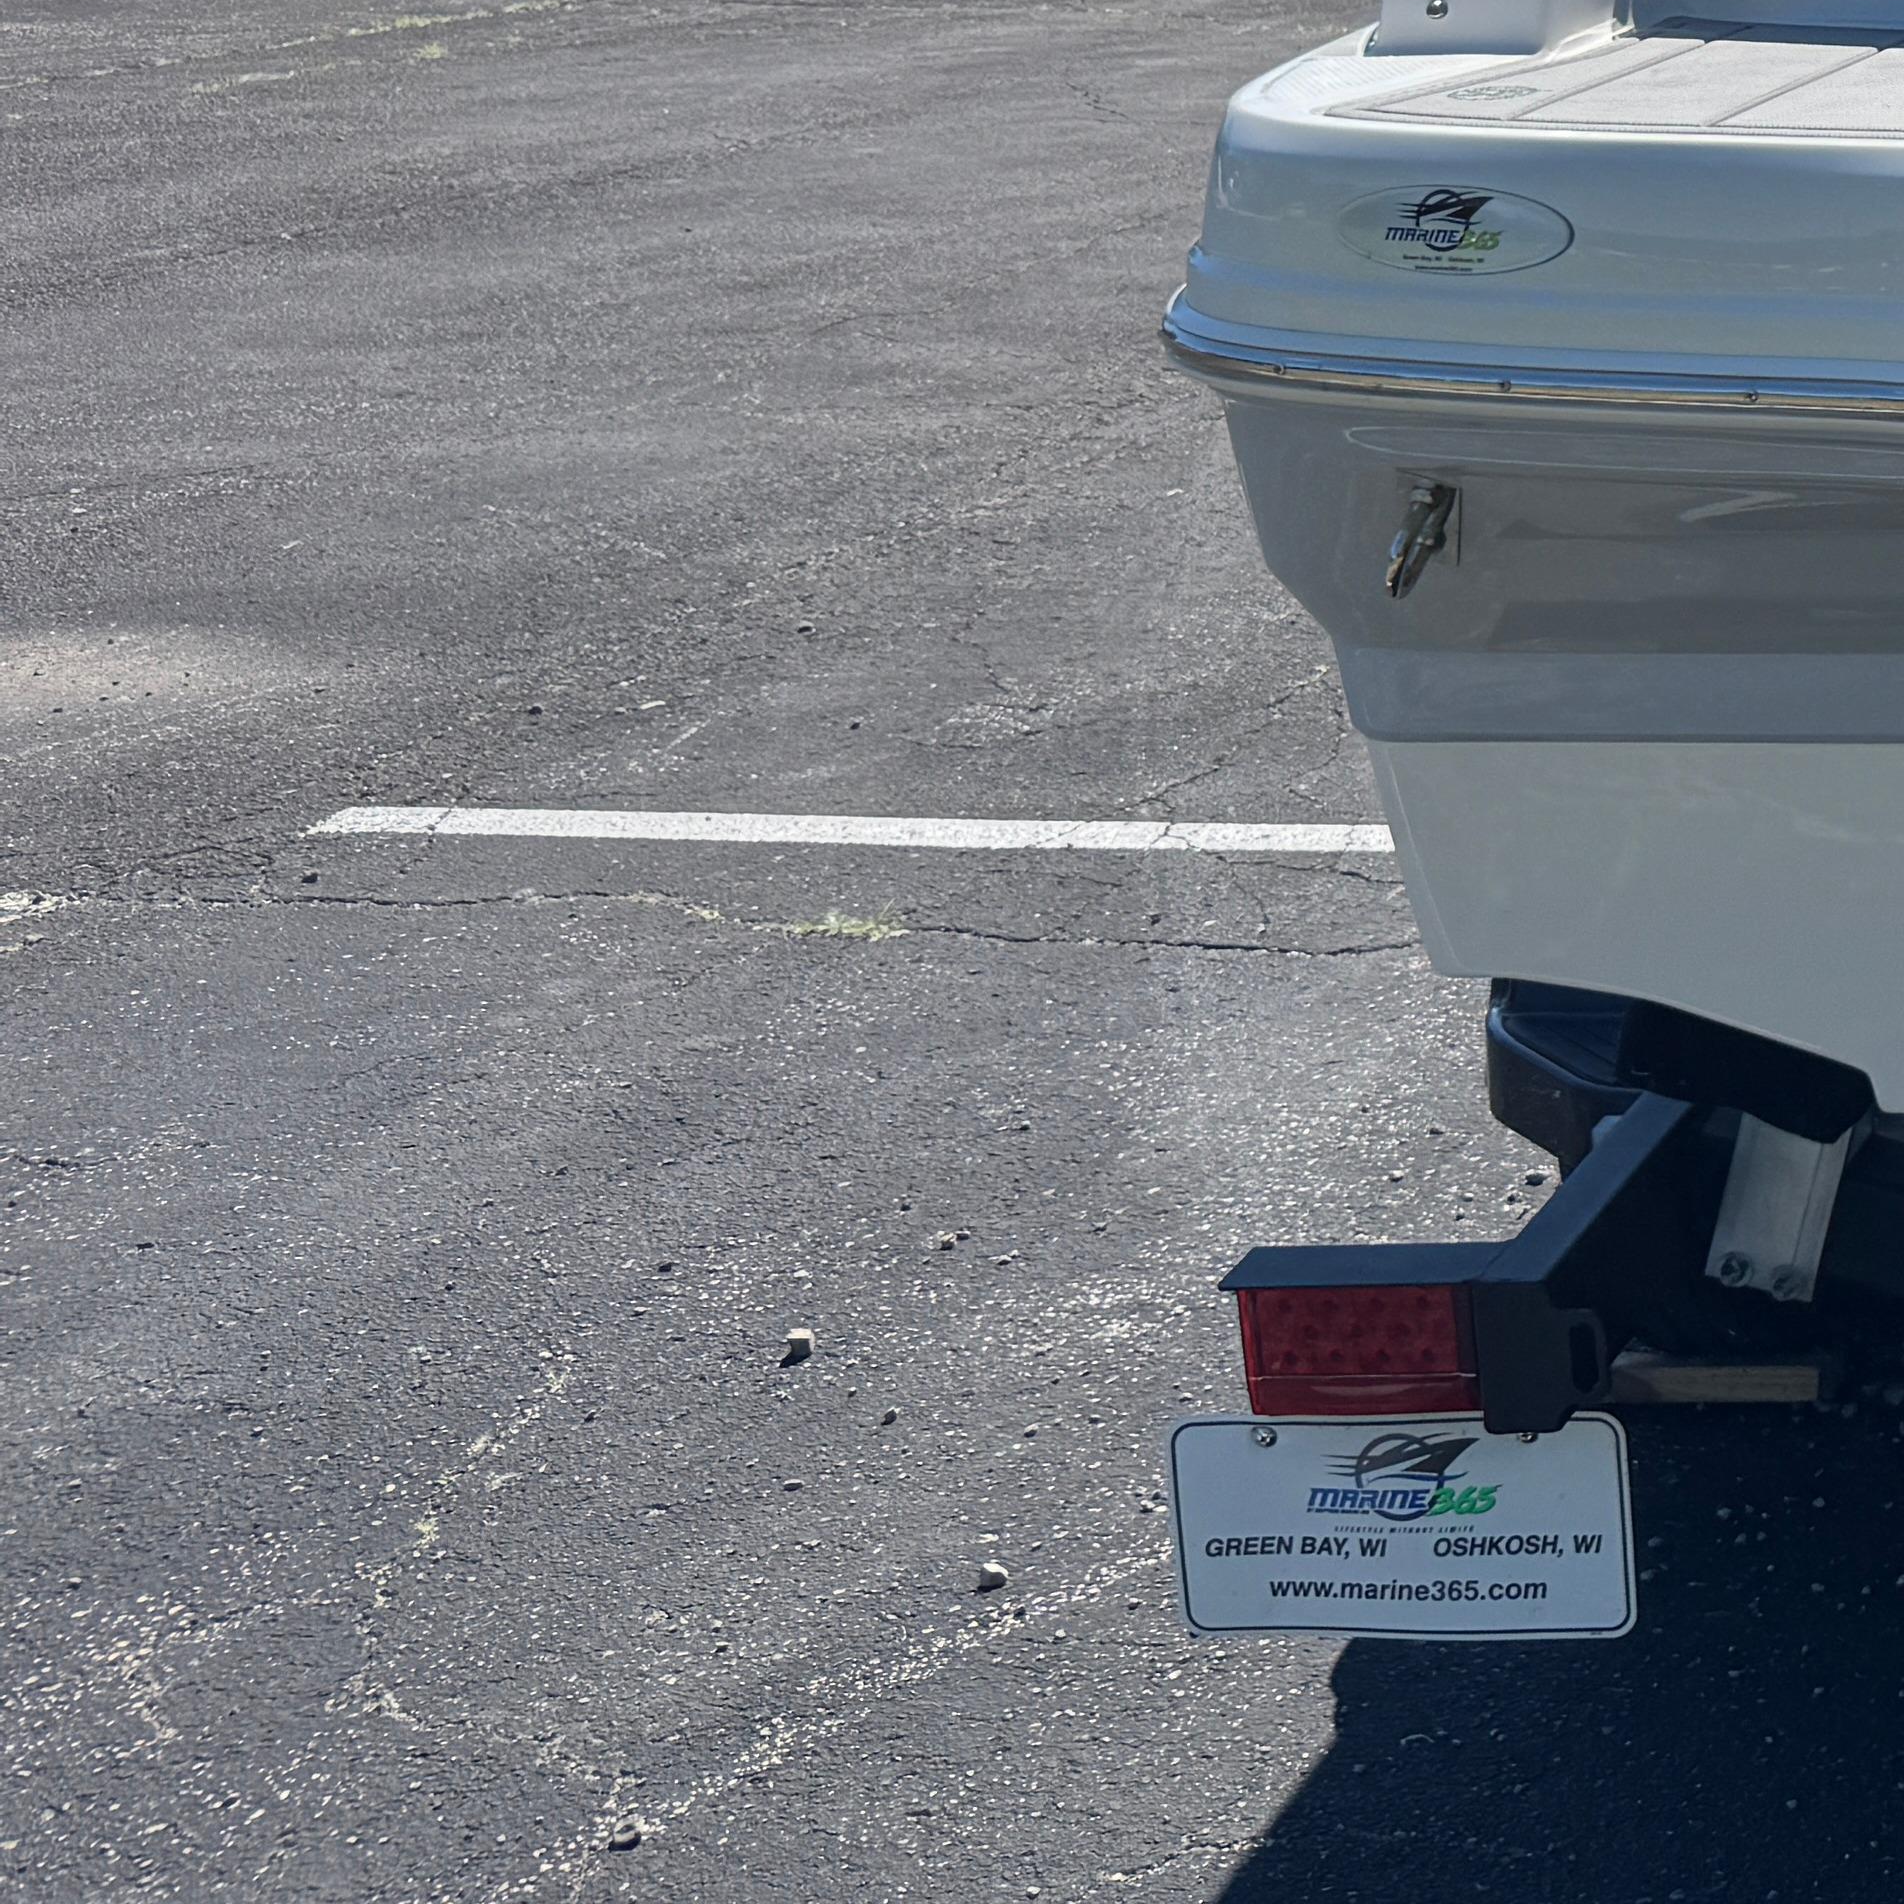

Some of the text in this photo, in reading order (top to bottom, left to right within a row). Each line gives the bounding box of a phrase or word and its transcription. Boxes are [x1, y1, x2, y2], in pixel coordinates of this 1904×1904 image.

[1204, 1533, 1603, 1561] GREEN BAY, WI OSHKOSH, WI
[1269, 1579, 1548, 1602] www.marine365.com
